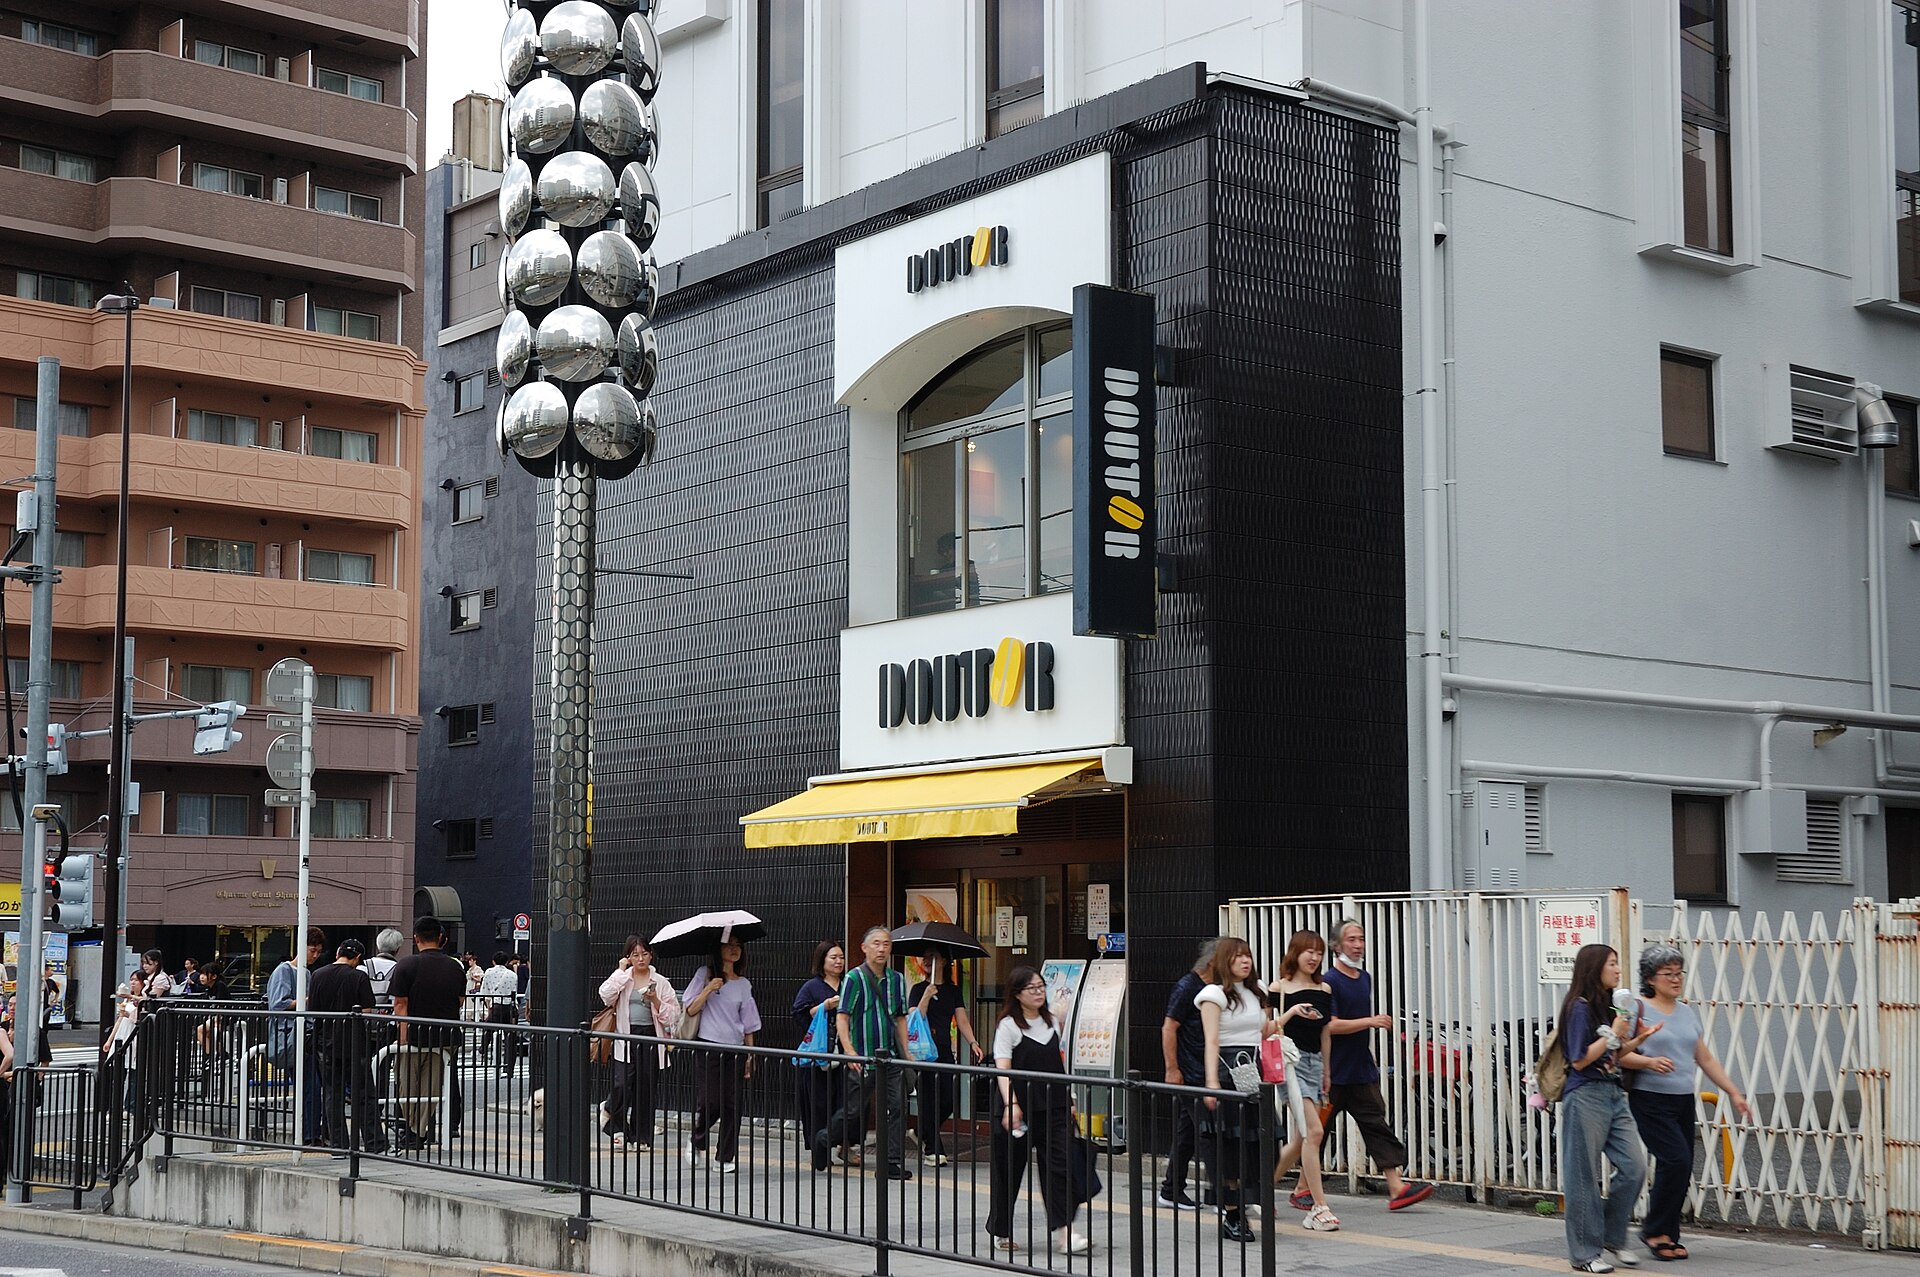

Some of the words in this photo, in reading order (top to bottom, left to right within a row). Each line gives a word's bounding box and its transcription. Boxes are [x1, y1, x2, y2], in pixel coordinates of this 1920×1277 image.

[907, 225, 1009, 294] DOUTOR
[1104, 367, 1145, 560] DOUTOR
[879, 637, 1055, 729] DOUTOR
[857, 820, 888, 835] DOUTOR
[1543, 915, 1596, 929] 月極駐車場
[1556, 932, 1582, 945] 募集
